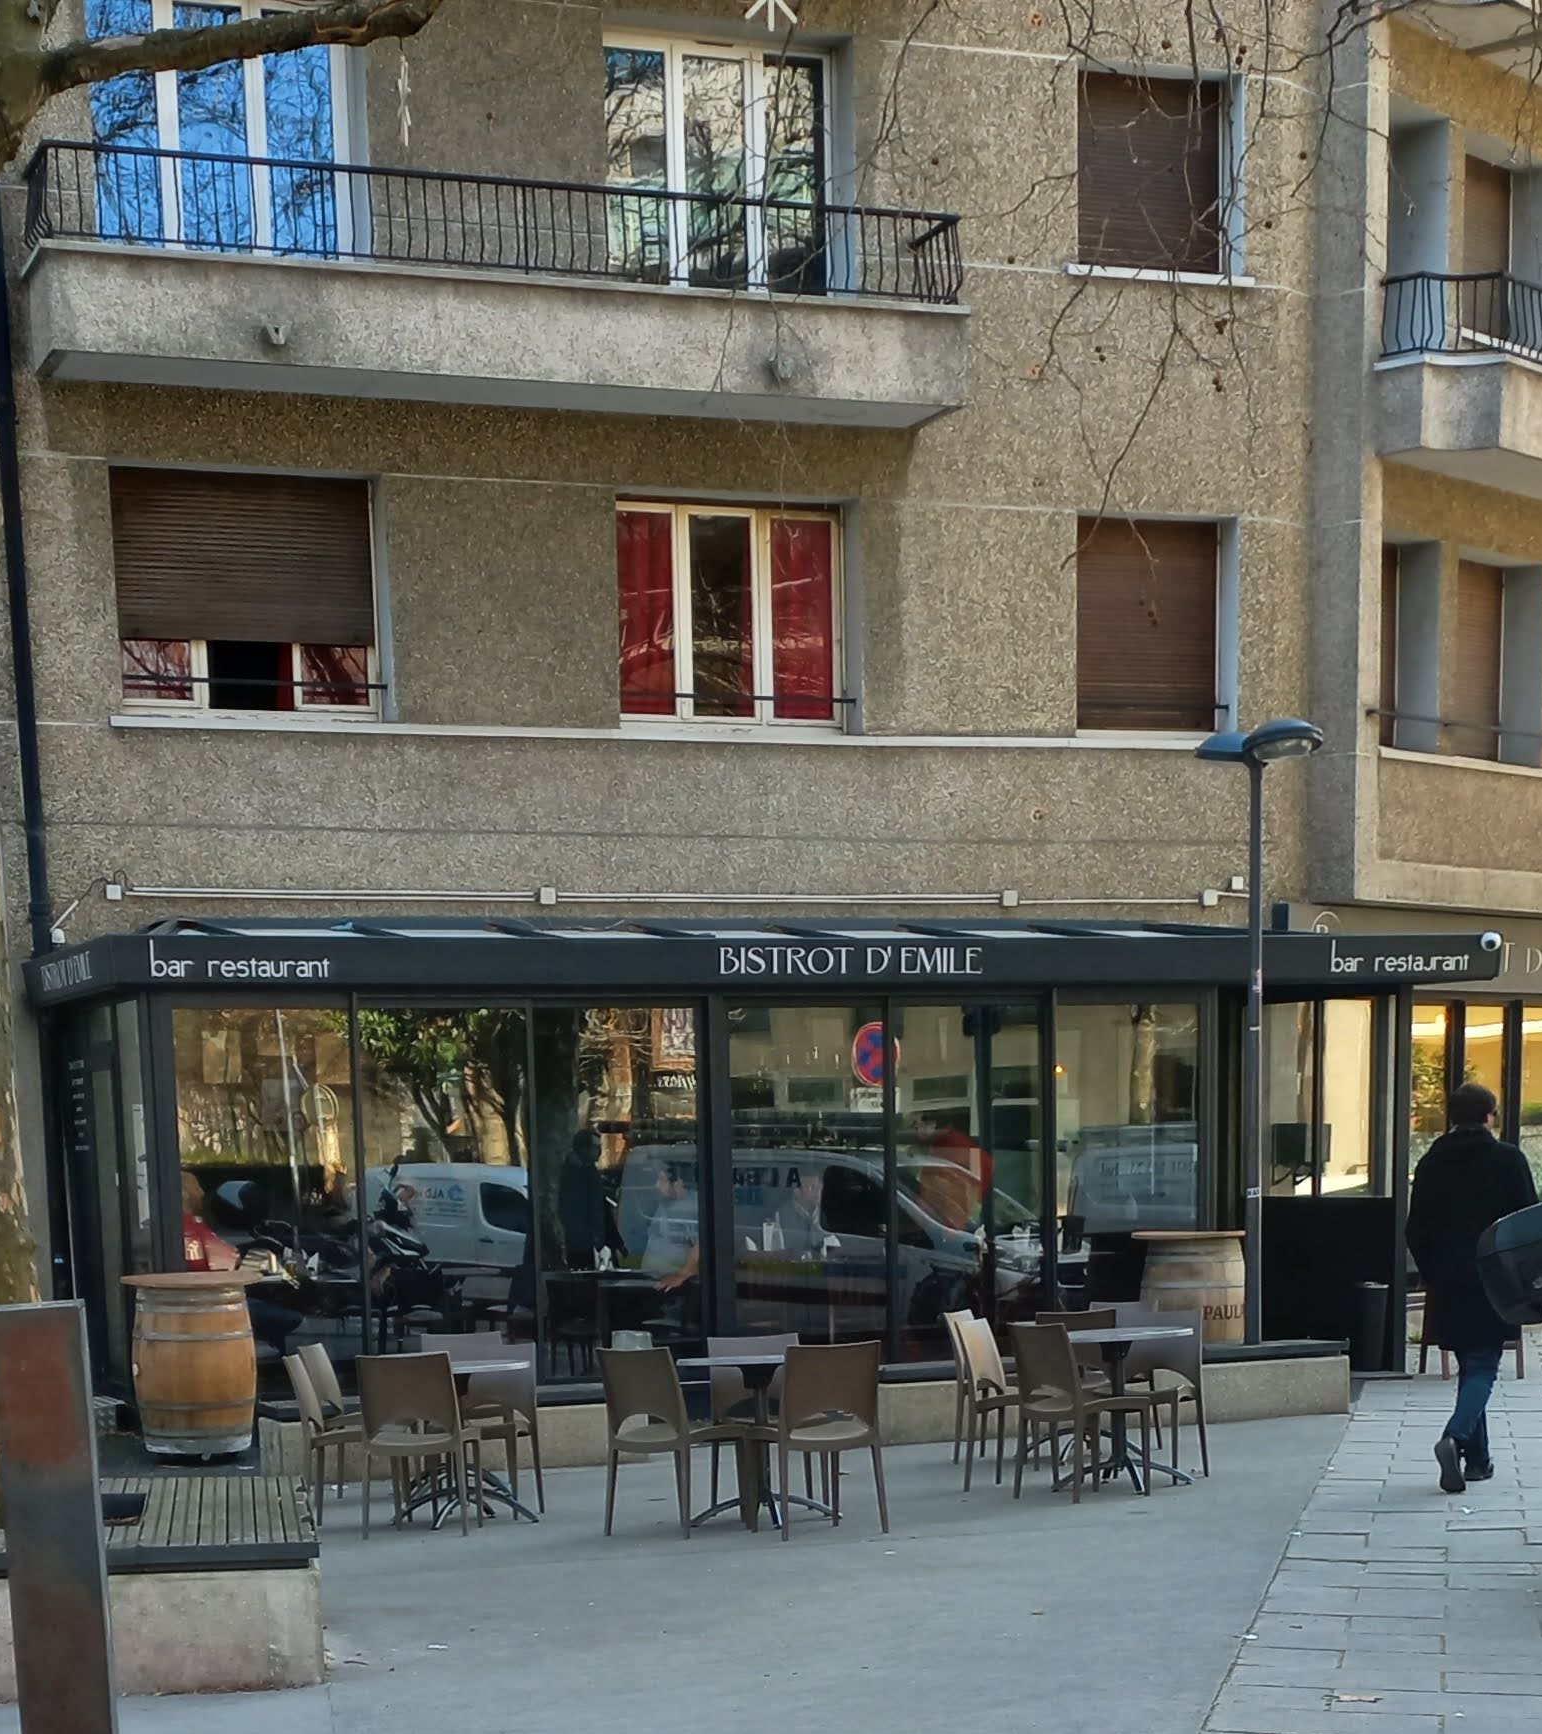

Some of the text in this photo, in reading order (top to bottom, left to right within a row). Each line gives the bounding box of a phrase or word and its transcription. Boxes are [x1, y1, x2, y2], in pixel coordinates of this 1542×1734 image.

[148, 936, 330, 978] bar restaurant
[719, 946, 855, 975] BISTROT
[1330, 939, 1363, 973] bar
